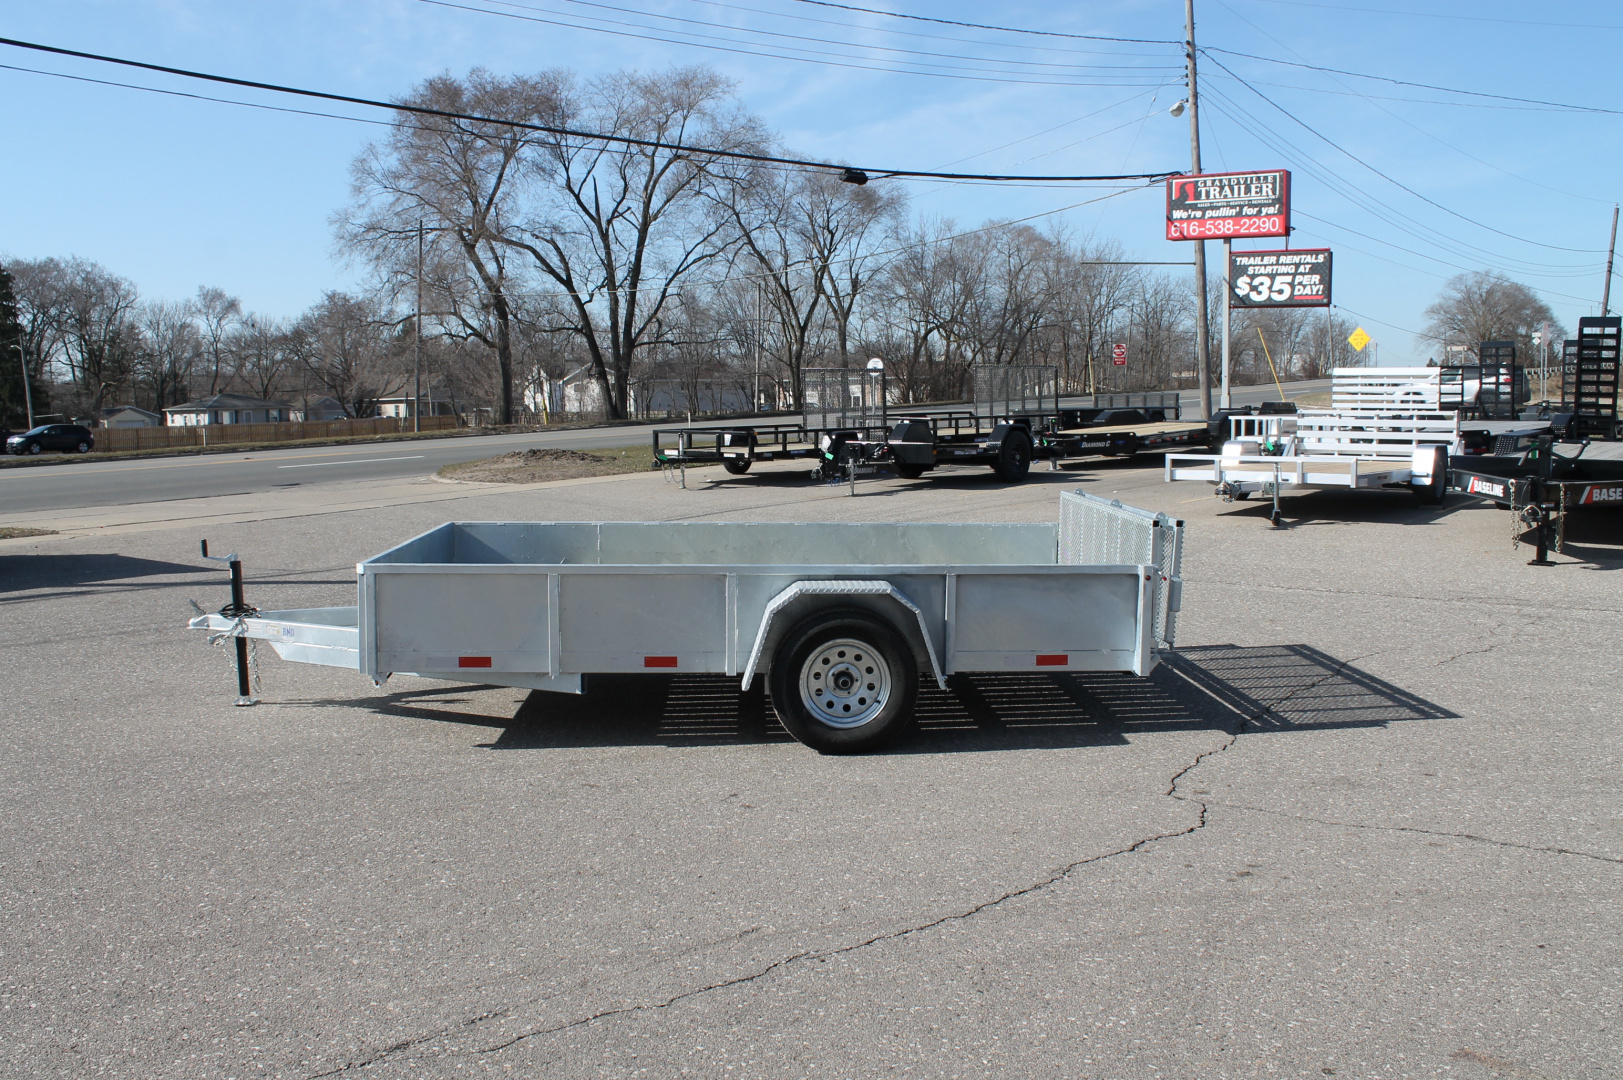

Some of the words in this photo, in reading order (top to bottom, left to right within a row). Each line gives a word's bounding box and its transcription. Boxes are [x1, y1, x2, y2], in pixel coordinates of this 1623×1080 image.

[1198, 175, 1274, 187] GRANDVILLE
[1198, 183, 1273, 200] TRAILER
[1172, 209, 1202, 219] We're
[1205, 206, 1239, 219] pullin'
[1242, 206, 1259, 216] for
[1261, 204, 1280, 216] ya!
[1171, 218, 1279, 236] 616-538-2290
[1235, 255, 1277, 265] TRAILER
[1279, 254, 1325, 264] RENTALS
[1247, 265, 1295, 275] STARTING
[1297, 264, 1312, 273] AT
[1294, 274, 1321, 285] PER
[1234, 274, 1293, 302] $35
[1294, 284, 1324, 296] DAY!
[1473, 480, 1503, 497] BASELINE
[1592, 488, 1623, 501] BASE
